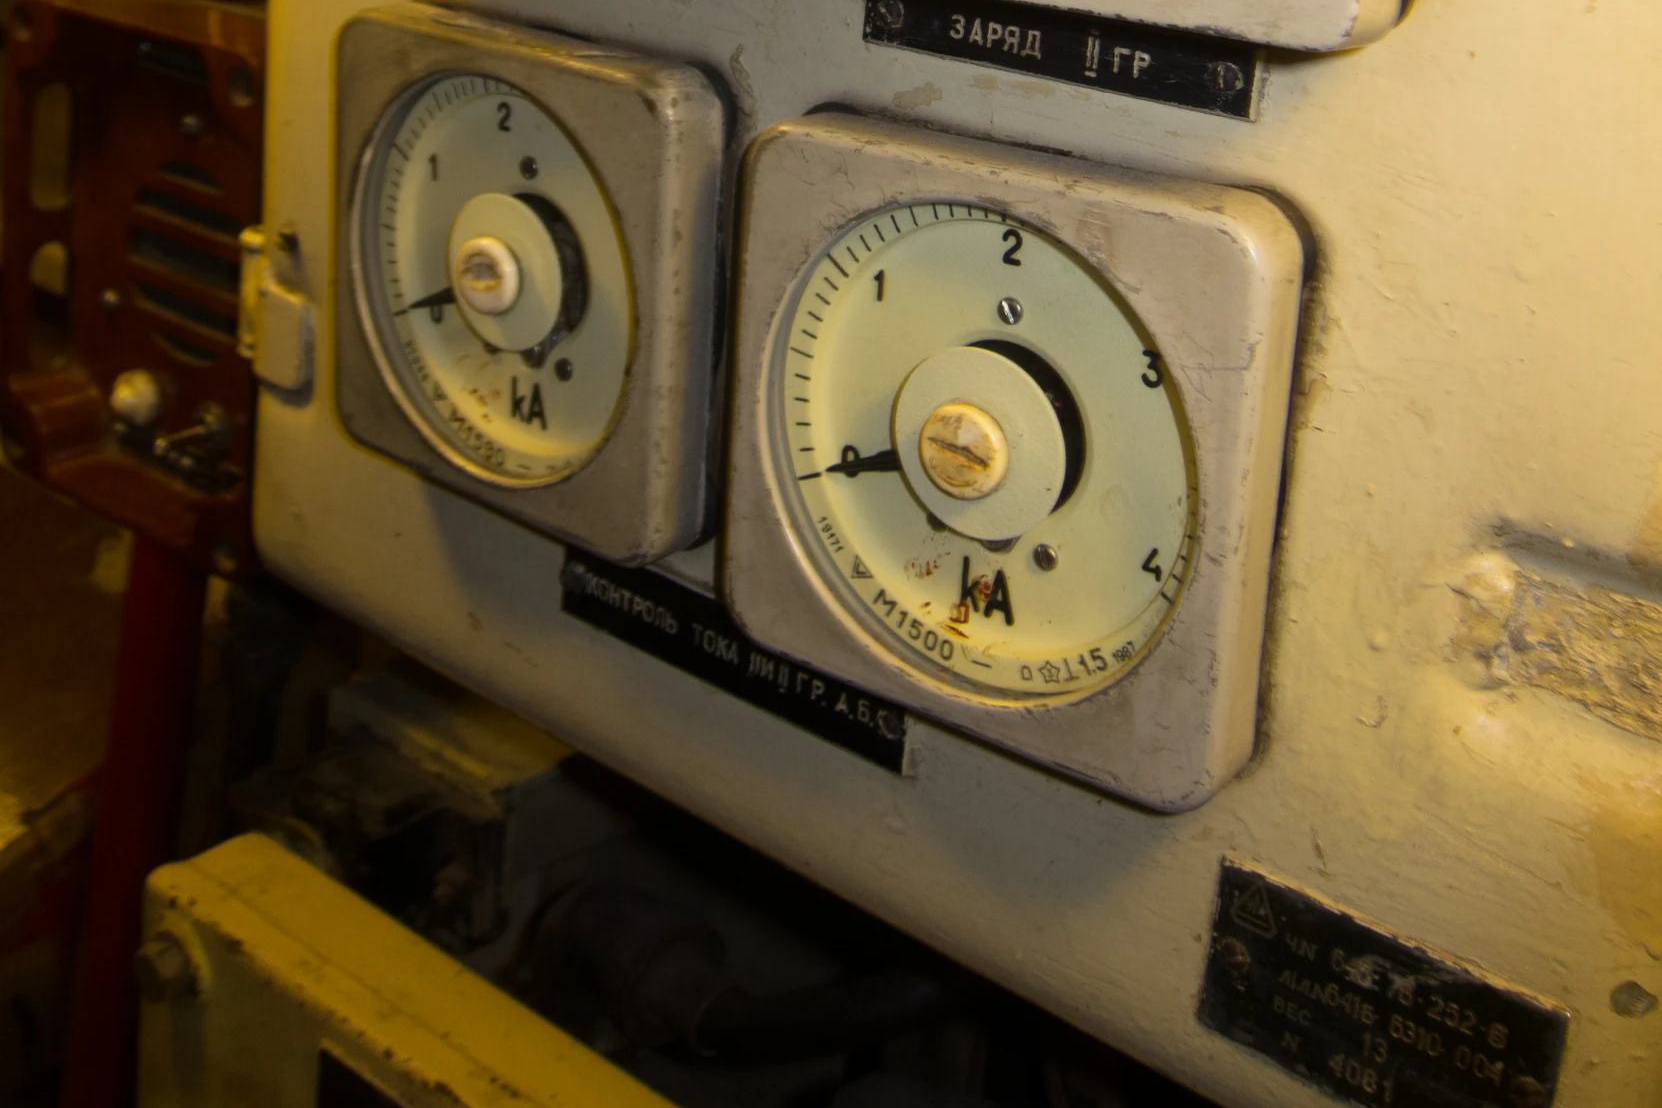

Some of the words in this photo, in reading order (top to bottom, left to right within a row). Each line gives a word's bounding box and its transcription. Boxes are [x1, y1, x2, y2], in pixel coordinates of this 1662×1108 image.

[951, 14, 1042, 60] ЗАРЯД
[1113, 46, 1151, 79] ГР
[497, 102, 511, 131] 2
[428, 154, 438, 182] 1
[1002, 228, 1023, 266] 2
[873, 269, 886, 302] 1
[1141, 349, 1165, 388] 3
[1141, 548, 1163, 582] 4
[585, 572, 678, 635] КОНТРОЛЬ
[691, 623, 739, 665] ТОКА
[1111, 641, 1136, 664] 1987
